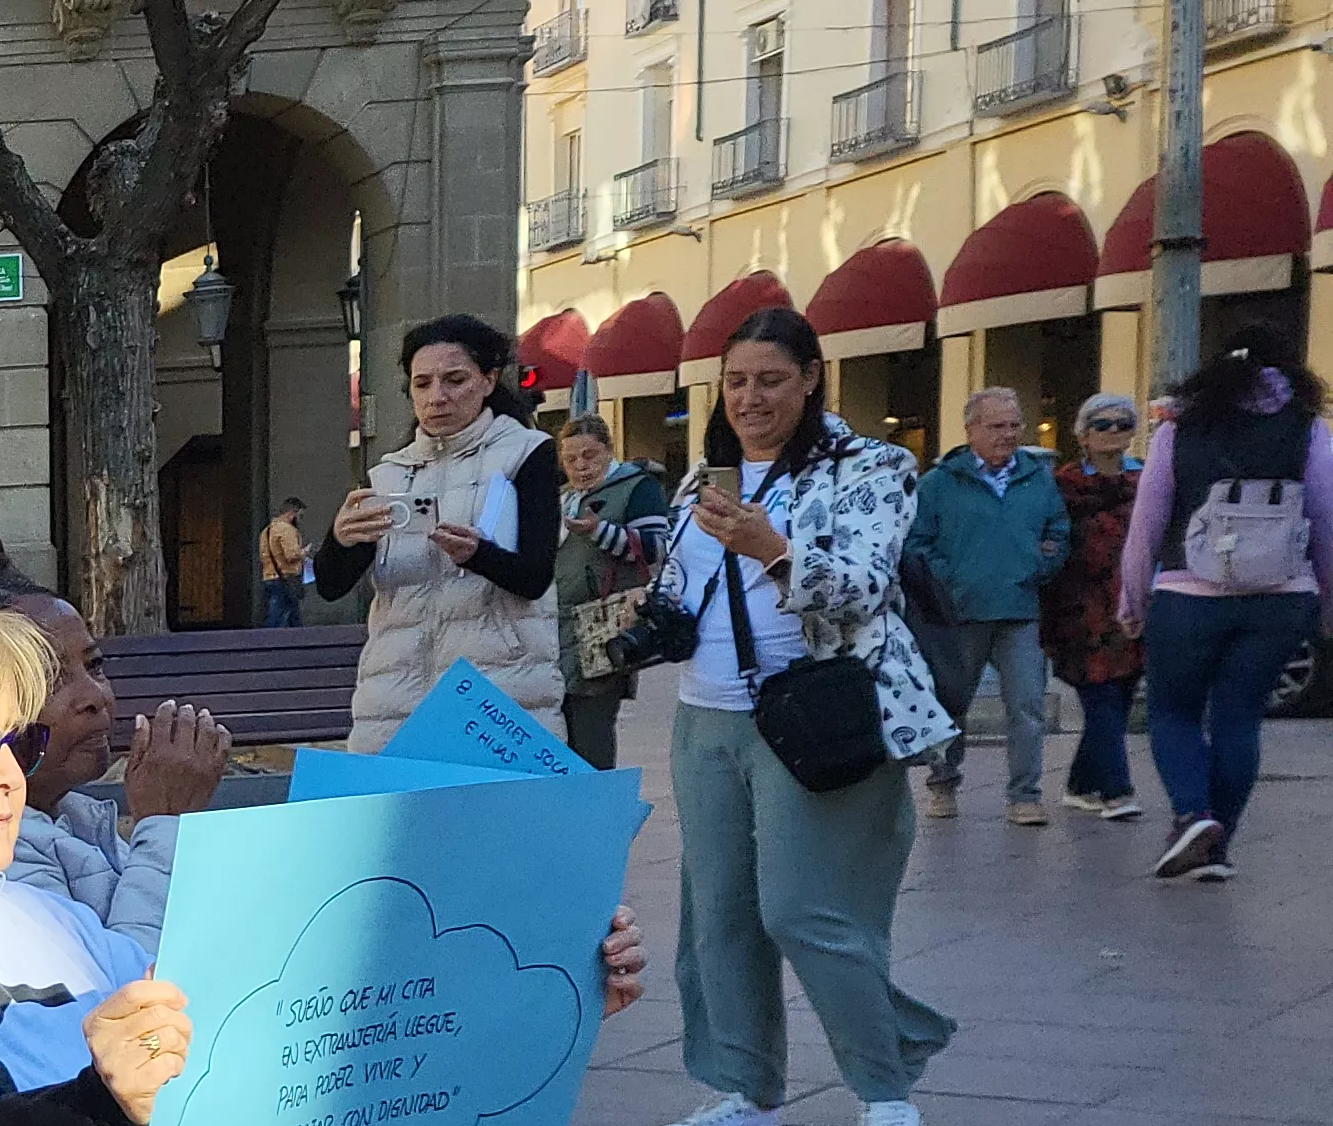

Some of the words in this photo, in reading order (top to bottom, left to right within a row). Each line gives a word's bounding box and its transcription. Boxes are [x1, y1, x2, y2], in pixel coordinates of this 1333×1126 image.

[477, 698, 532, 746] MADRES
[477, 731, 519, 764] HIJAS
[340, 986, 373, 1016] QUE
[377, 983, 396, 1007] MI
[402, 977, 435, 999] CITA
[282, 1042, 298, 1068] EN
[405, 1012, 462, 1037] LLEGUE,
[277, 1084, 307, 1116] PARA
[315, 1065, 353, 1099] PODER
[365, 1058, 403, 1083] VIVIR
[410, 1053, 427, 1078] Y
